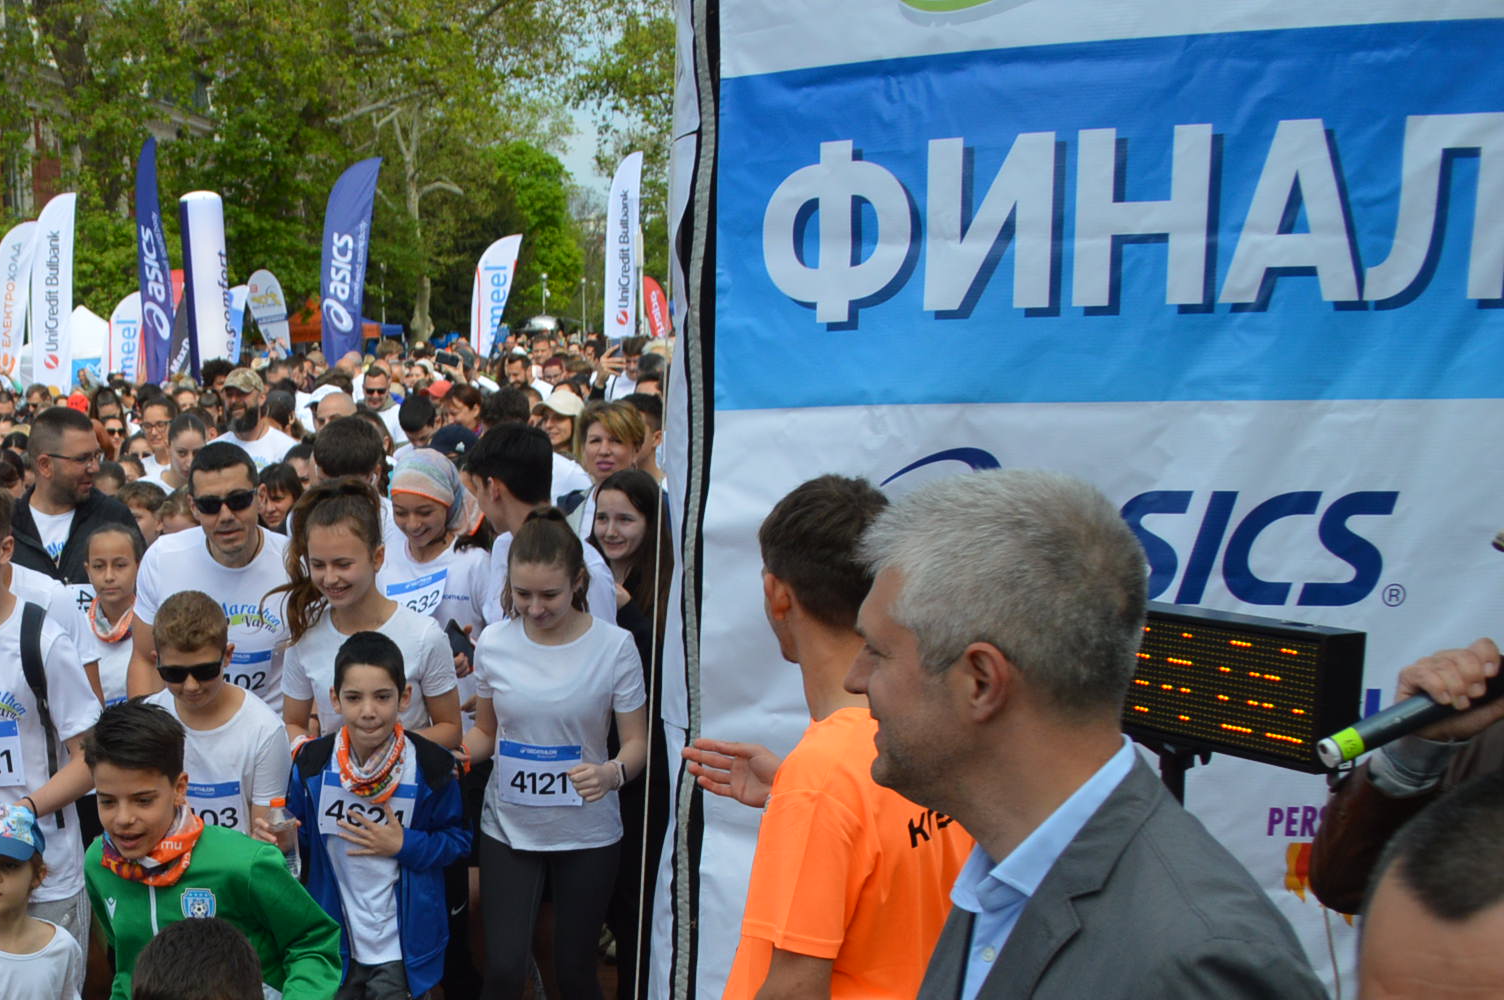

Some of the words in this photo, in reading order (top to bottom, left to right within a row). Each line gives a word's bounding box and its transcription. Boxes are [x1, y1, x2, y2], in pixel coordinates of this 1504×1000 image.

[617, 190, 630, 245] Bulbank
[763, 112, 1504, 331] ФИНАЛ
[45, 230, 60, 286] Bulbank
[329, 232, 353, 301] asics
[616, 248, 630, 308] UniCredit
[45, 288, 60, 351] UniCredit
[1120, 489, 1401, 607] SICS
[406, 589, 440, 614] 632
[510, 770, 568, 795] 4121
